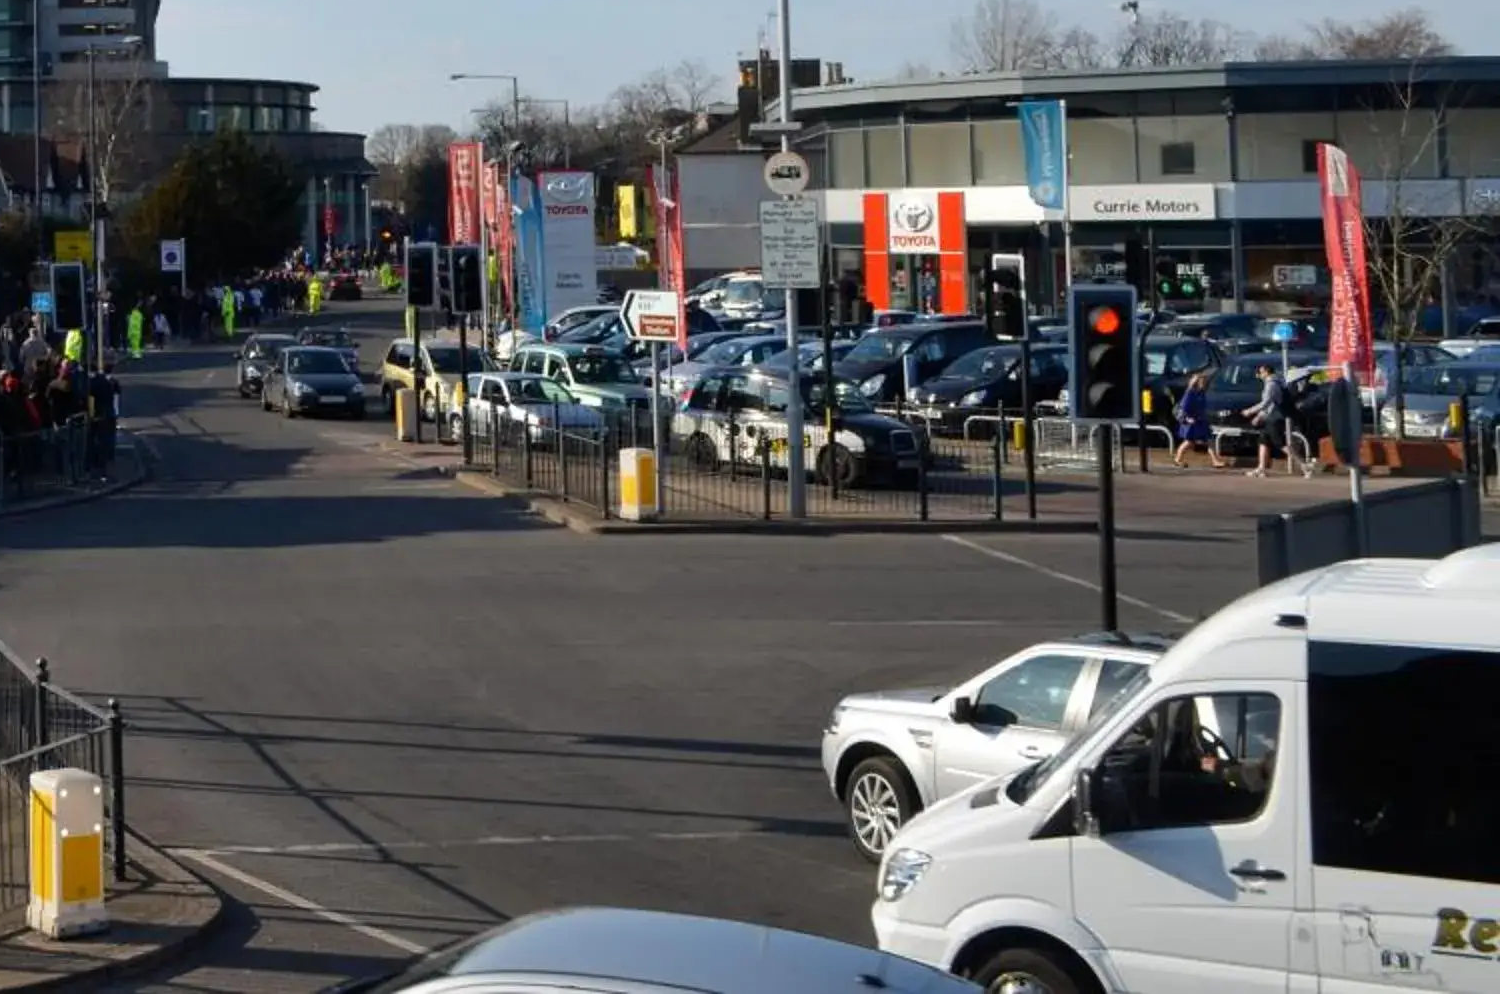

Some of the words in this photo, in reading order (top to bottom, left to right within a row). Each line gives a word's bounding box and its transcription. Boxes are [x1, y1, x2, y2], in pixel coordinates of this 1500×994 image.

[546, 205, 589, 216] TOYOTA
[1093, 199, 1141, 214] Currie
[1145, 199, 1200, 213] Motors
[892, 235, 936, 248] TOYOTA
